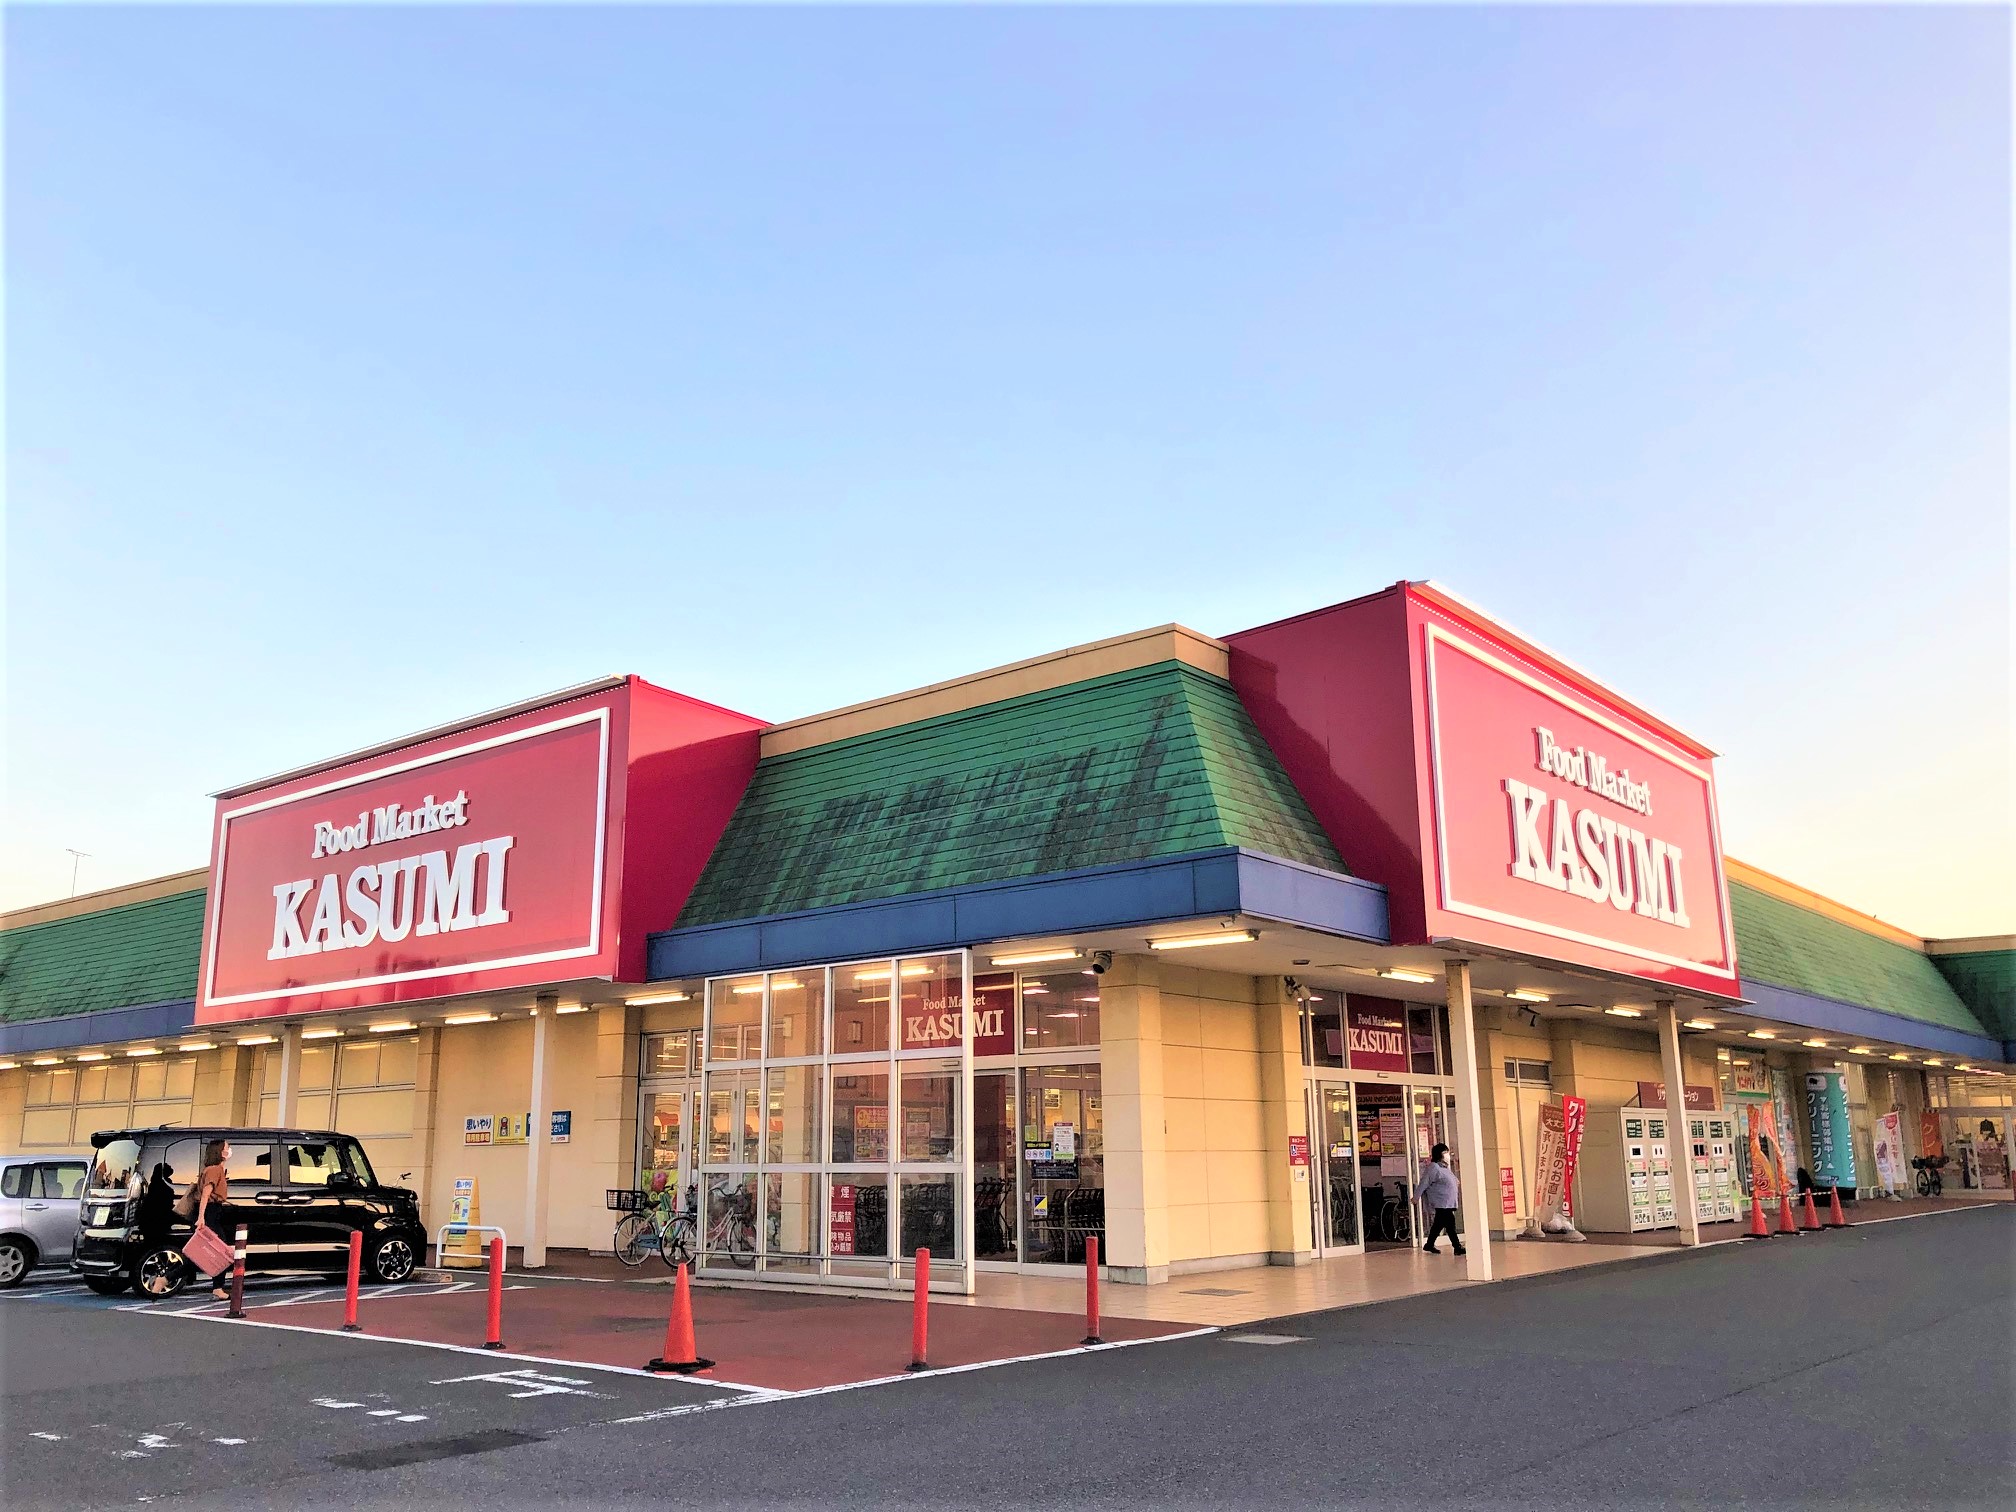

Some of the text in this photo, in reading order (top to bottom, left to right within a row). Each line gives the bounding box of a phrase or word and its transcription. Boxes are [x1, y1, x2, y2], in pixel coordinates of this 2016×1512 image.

[1534, 726, 1653, 817] Food Market
[311, 789, 470, 858] Food Market
[1502, 778, 1691, 929] KASUMI
[267, 835, 516, 961] KASUMI
[922, 993, 986, 1010] Food Maket
[1357, 1013, 1372, 1025] Food
[1349, 1027, 1404, 1055] KASUMI
[466, 1118, 492, 1130] 思いやり
[1807, 1092, 1823, 1173] クリーニング
[831, 1211, 852, 1223] 気厳禁
